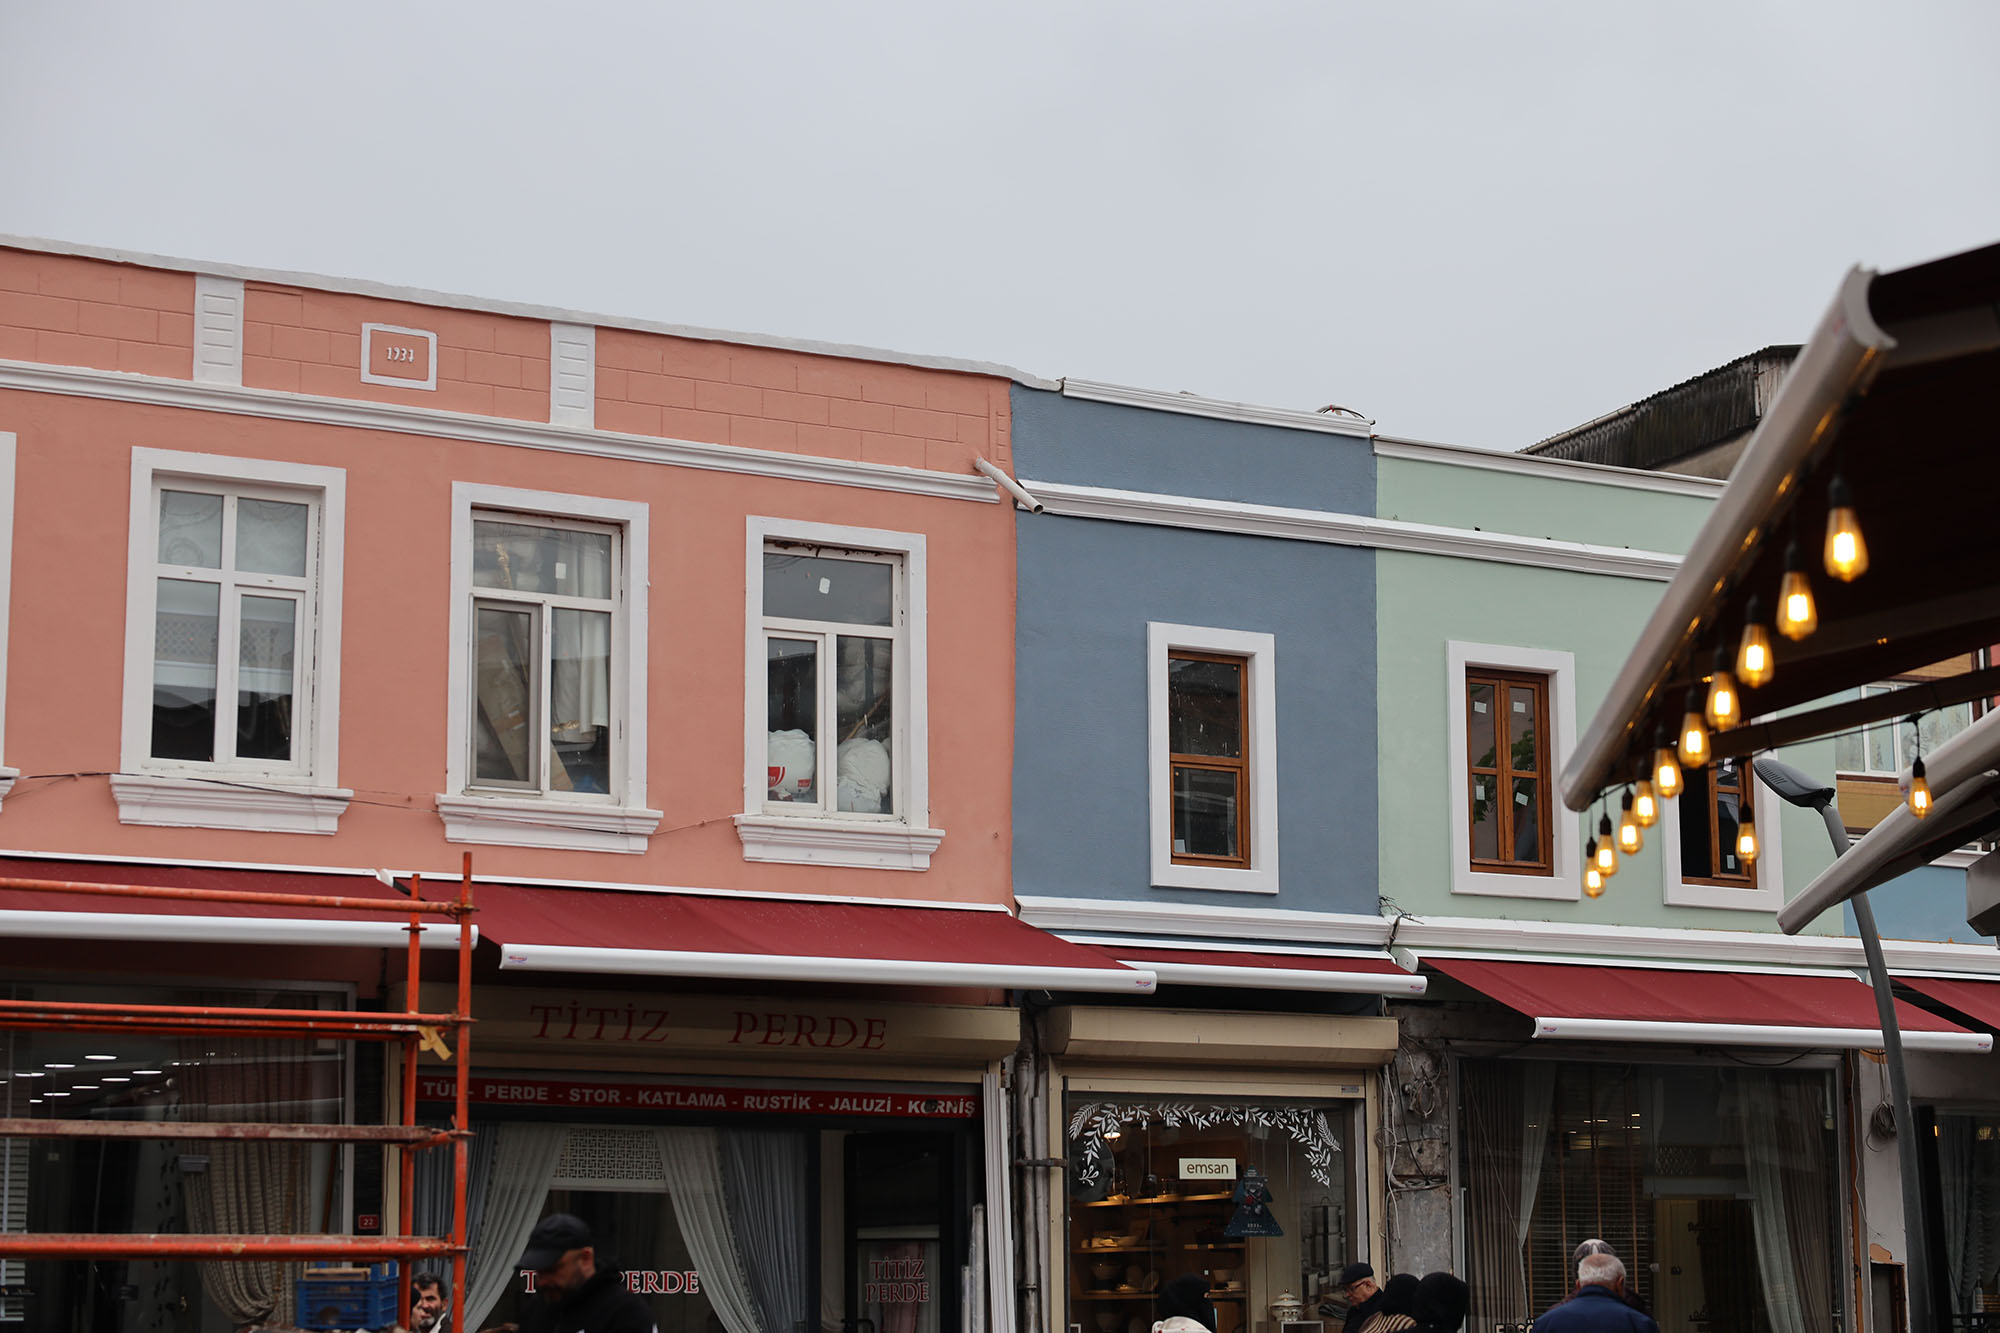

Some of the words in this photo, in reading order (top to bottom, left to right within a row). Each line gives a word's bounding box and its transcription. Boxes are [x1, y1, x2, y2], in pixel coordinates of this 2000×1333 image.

[530, 1000, 668, 1042] TİTİZ
[728, 1011, 887, 1050] PERDE
[485, 1084, 548, 1100] PERDE
[569, 1088, 620, 1103] STOR
[638, 1090, 727, 1107] KATLAMA
[743, 1092, 811, 1110] RUSTİK
[829, 1096, 891, 1112] JALUZİ
[1186, 1163, 1229, 1174] emsan
[869, 1256, 926, 1280] TİTİZ
[619, 1270, 699, 1293] ERDE
[865, 1282, 930, 1303] PERDE
